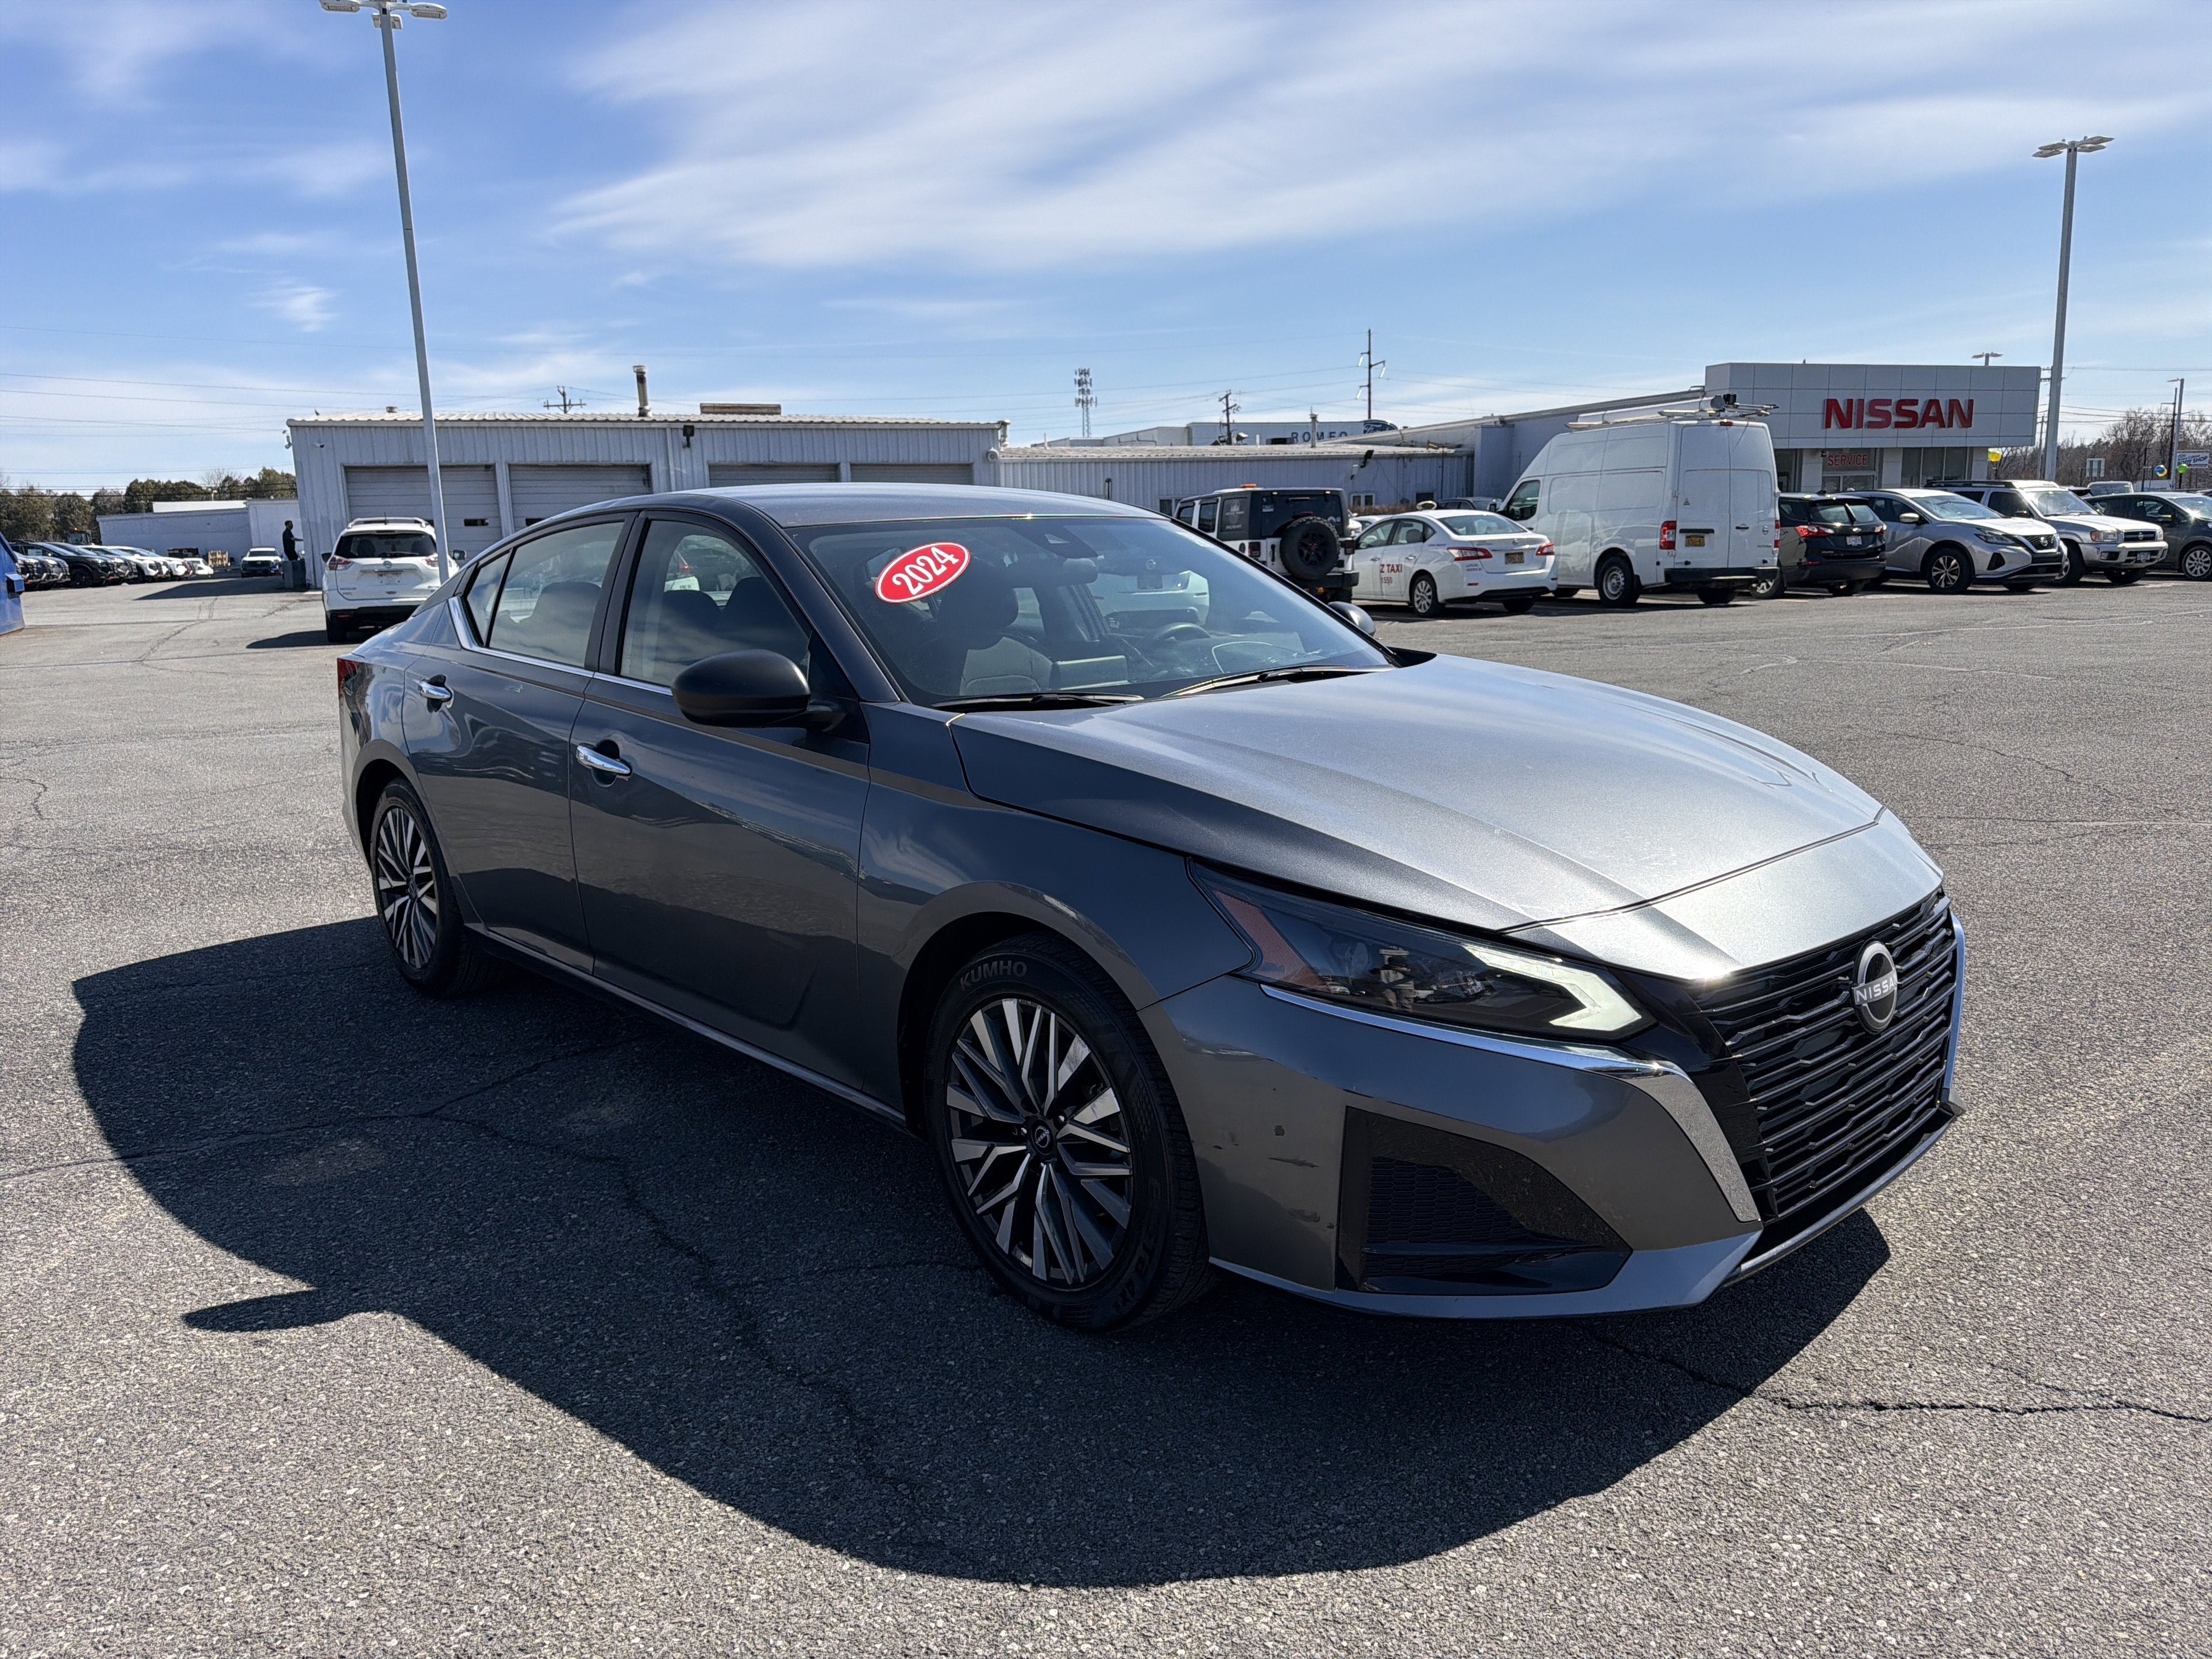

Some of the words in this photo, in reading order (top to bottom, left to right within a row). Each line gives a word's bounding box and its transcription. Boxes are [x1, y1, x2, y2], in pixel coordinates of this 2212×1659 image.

[1825, 398, 1974, 429] NISSAN
[1828, 454, 1868, 466] SERVICE
[892, 546, 959, 595] 2024
[1386, 563, 1403, 573] TAXI
[960, 960, 1028, 991] KUMHO
